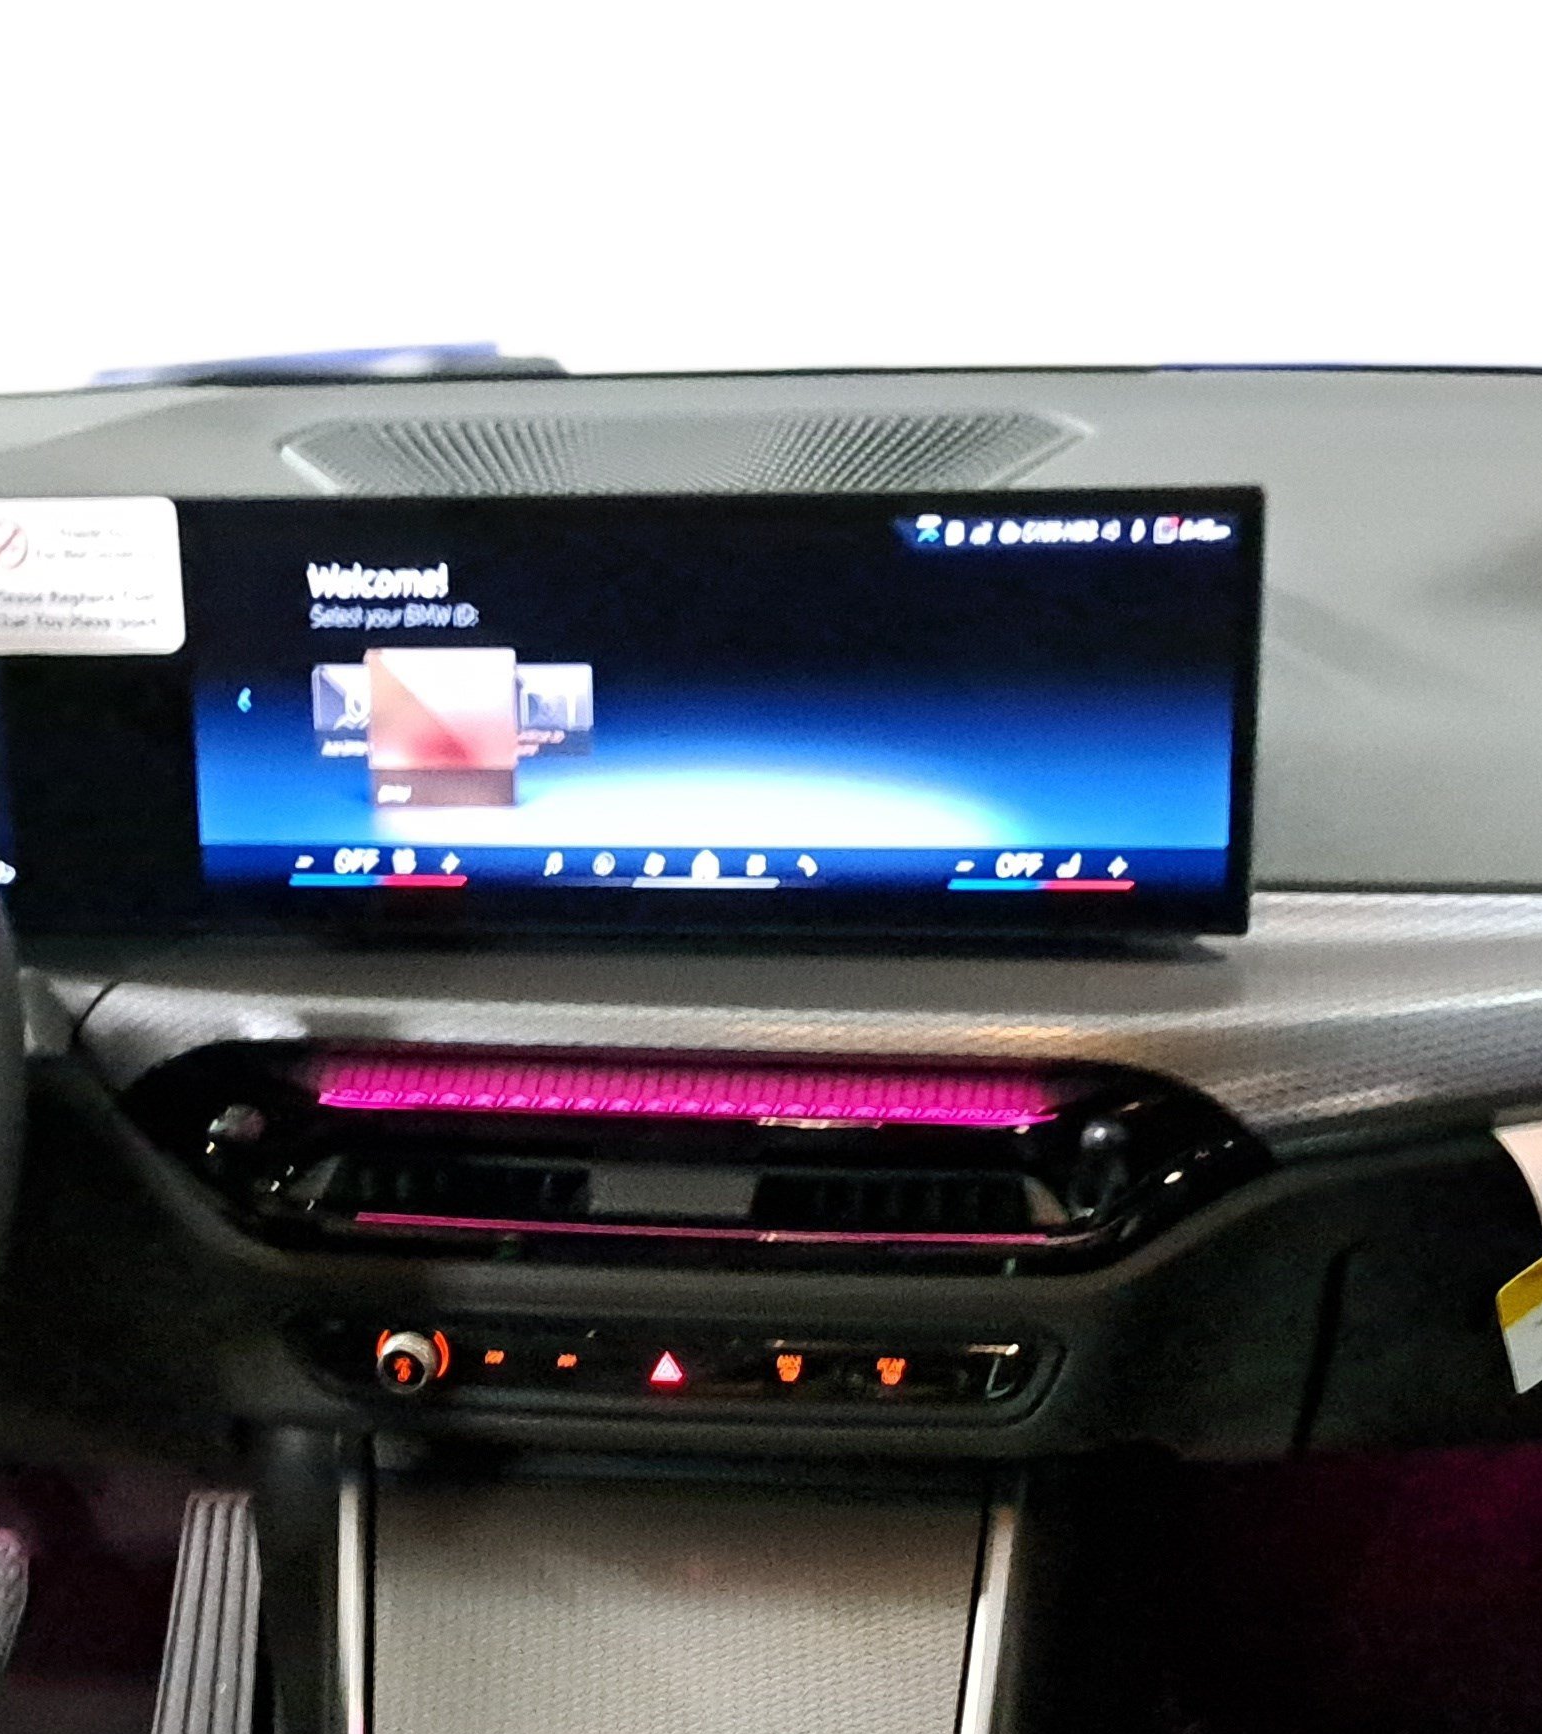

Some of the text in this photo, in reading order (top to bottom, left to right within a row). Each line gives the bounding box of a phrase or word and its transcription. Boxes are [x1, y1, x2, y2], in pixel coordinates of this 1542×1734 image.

[306, 562, 449, 600] Welcome!
[334, 848, 380, 875] OFF
[996, 853, 1043, 878] OFF
